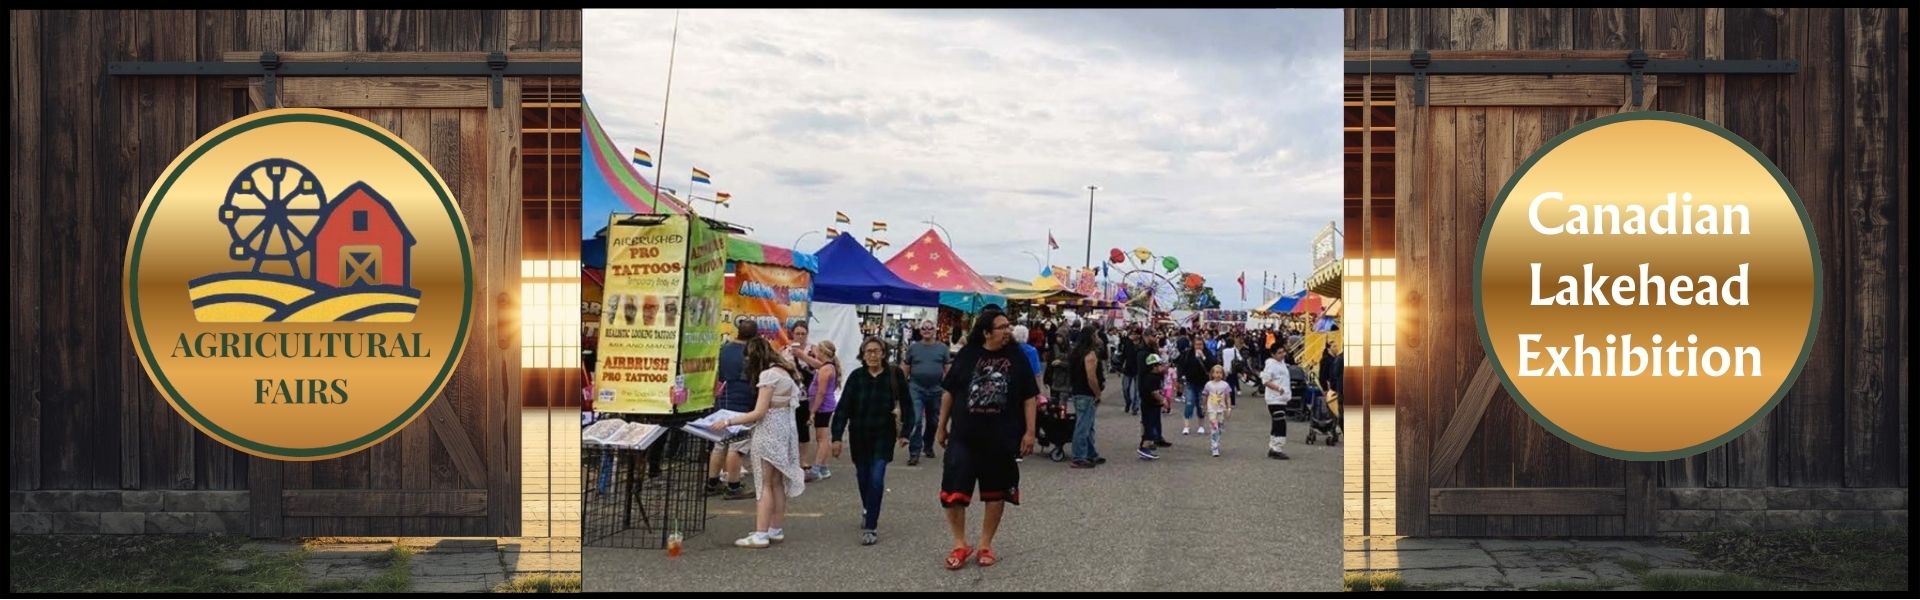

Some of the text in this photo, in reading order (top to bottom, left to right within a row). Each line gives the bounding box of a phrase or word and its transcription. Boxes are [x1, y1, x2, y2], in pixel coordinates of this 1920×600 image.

[613, 234, 683, 247] AIRBRUSHED
[629, 246, 660, 259] PRO
[612, 262, 682, 276] TATTOOS
[605, 328, 631, 339] REALISTIC
[631, 329, 653, 340] LOOKING
[654, 330, 677, 340] TATTOOS
[603, 356, 670, 371] AIRBRUSH
[602, 371, 668, 382] PRO TATTOOS
